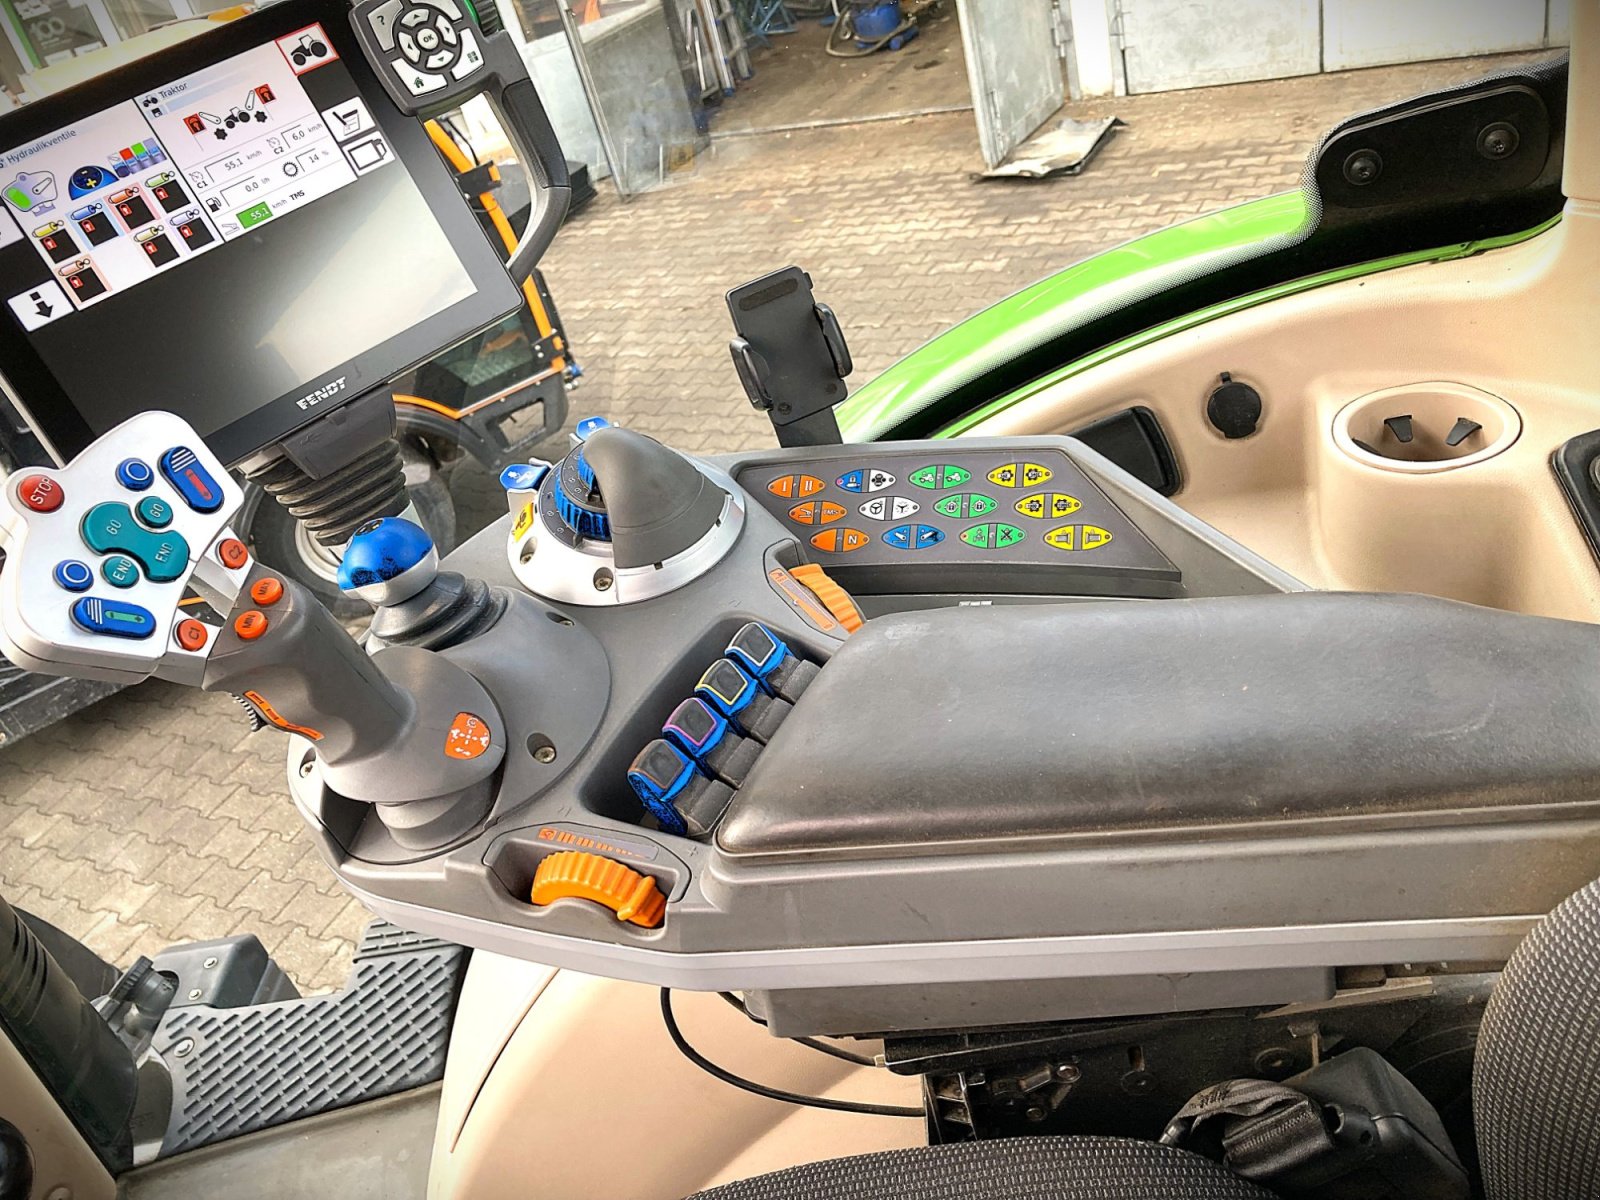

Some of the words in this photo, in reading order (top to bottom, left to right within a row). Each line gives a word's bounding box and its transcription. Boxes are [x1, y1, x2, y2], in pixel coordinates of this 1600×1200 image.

[423, 34, 434, 42] OK
[158, 82, 188, 99] Traktor
[6, 131, 77, 164] Hydraulikventile
[273, 146, 284, 155] C2
[224, 158, 244, 171] 55,1
[308, 154, 319, 163] 14
[196, 180, 208, 189] C1
[250, 207, 270, 220] 55,1
[289, 190, 305, 201] TMS
[295, 376, 346, 410] FENDT
[30, 477, 53, 505] STOP
[151, 503, 164, 518] GO
[106, 519, 122, 535] GO
[848, 535, 857, 544] N
[155, 542, 174, 562] END
[228, 544, 244, 560] C2
[113, 559, 132, 581] END
[188, 626, 201, 641] C1
